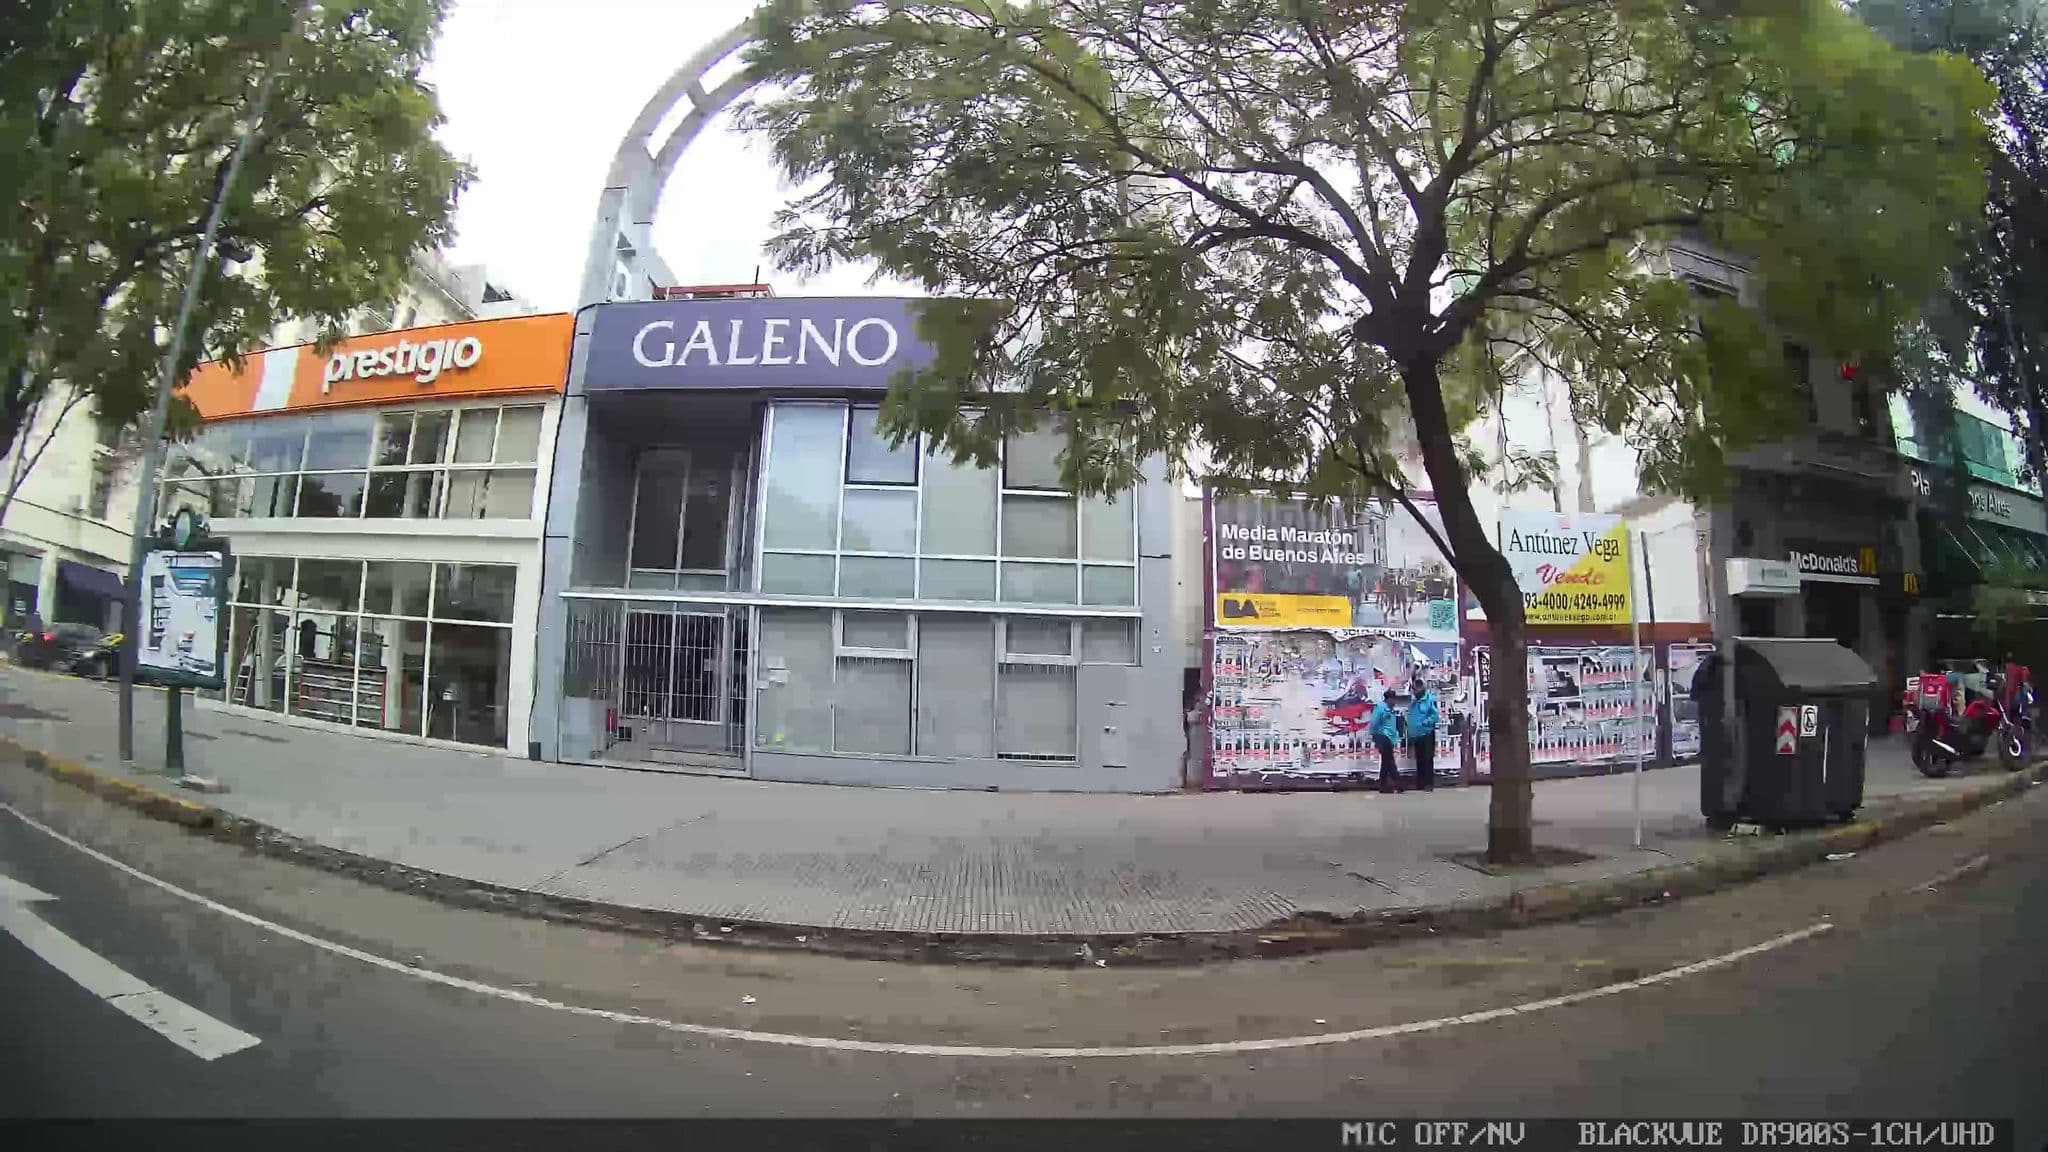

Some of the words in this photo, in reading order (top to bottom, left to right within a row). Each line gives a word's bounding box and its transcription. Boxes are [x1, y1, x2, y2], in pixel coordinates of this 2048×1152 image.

[632, 317, 898, 367] GALENO
[322, 337, 482, 394] prestigio
[1221, 524, 1278, 542] Media
[1281, 526, 1354, 545] Maratón
[1509, 526, 1580, 556] Antúnez
[1582, 531, 1622, 562] Vega
[1222, 545, 1246, 560] de
[1249, 545, 1318, 563] Buenos
[1321, 549, 1367, 566] Aires
[1790, 550, 1858, 574] McDonald's
[1524, 593, 1625, 611] 93-4000/4249-4999
